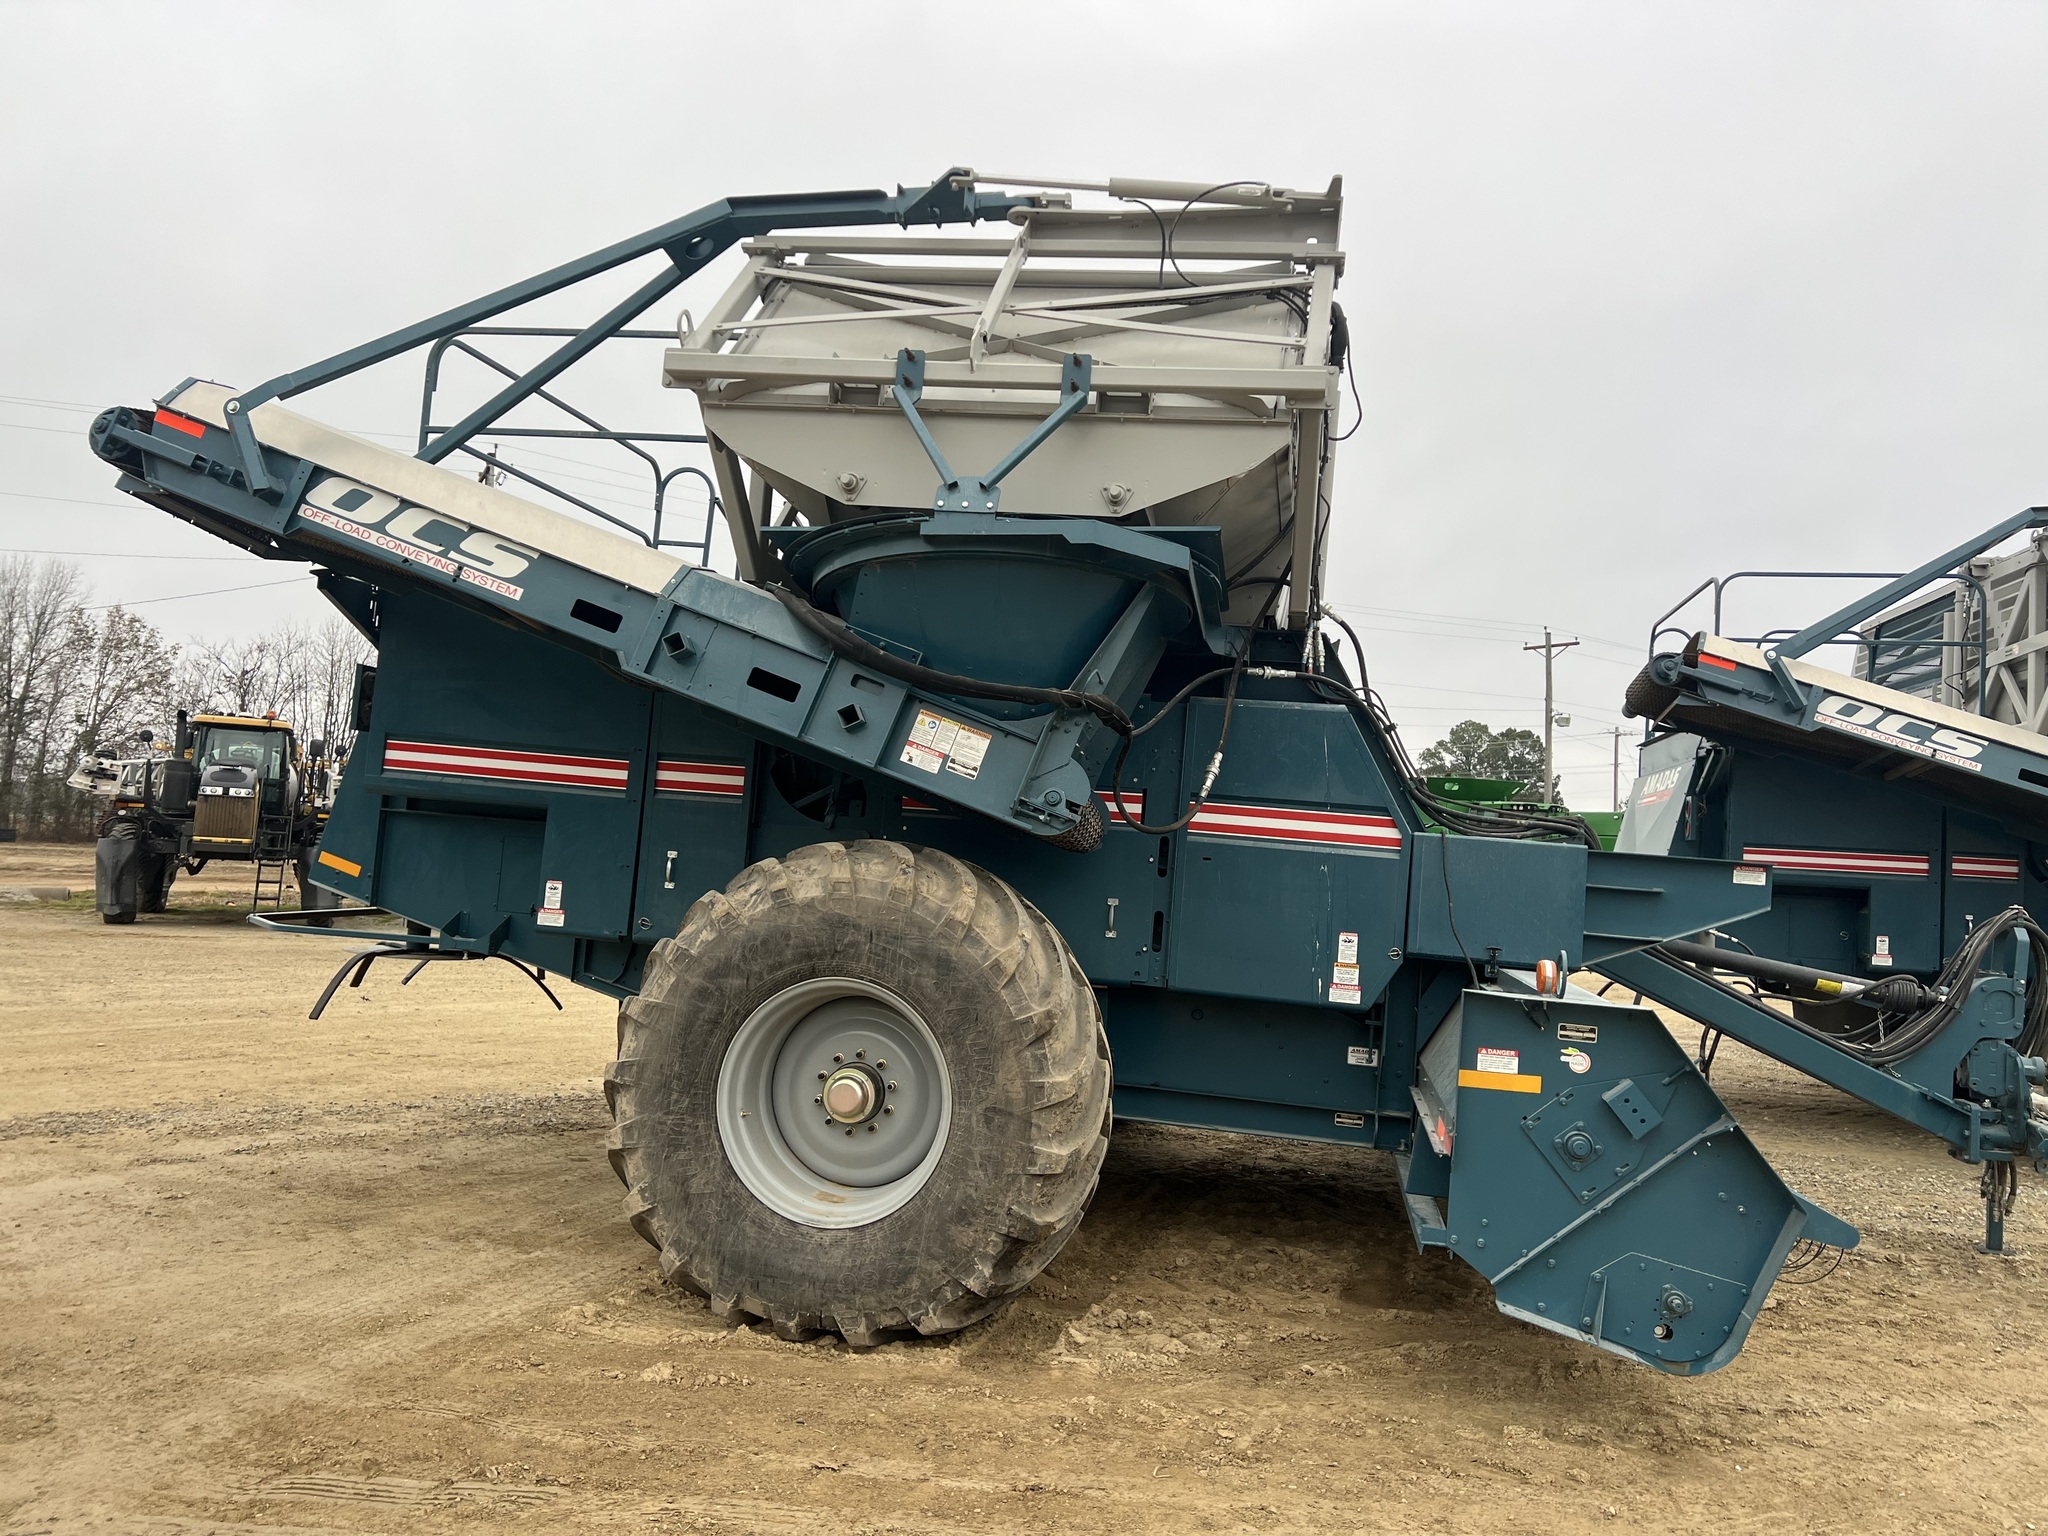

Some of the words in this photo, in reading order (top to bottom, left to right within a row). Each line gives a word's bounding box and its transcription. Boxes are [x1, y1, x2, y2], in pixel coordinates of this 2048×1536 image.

[303, 506, 372, 540] OFF-LOAD
[376, 535, 457, 574] CONVEYING
[461, 568, 518, 598] SYSTEM
[305, 476, 540, 578] OCS
[917, 744, 940, 757] DANGER
[1815, 714, 1868, 736] OFF-LOAD
[1871, 731, 1933, 756] CONVEYING
[1936, 752, 1979, 770] SYSTEM
[1817, 695, 1989, 758] OCS
[1640, 766, 1682, 797] AMADAS
[1487, 1049, 1516, 1057] DANGER
